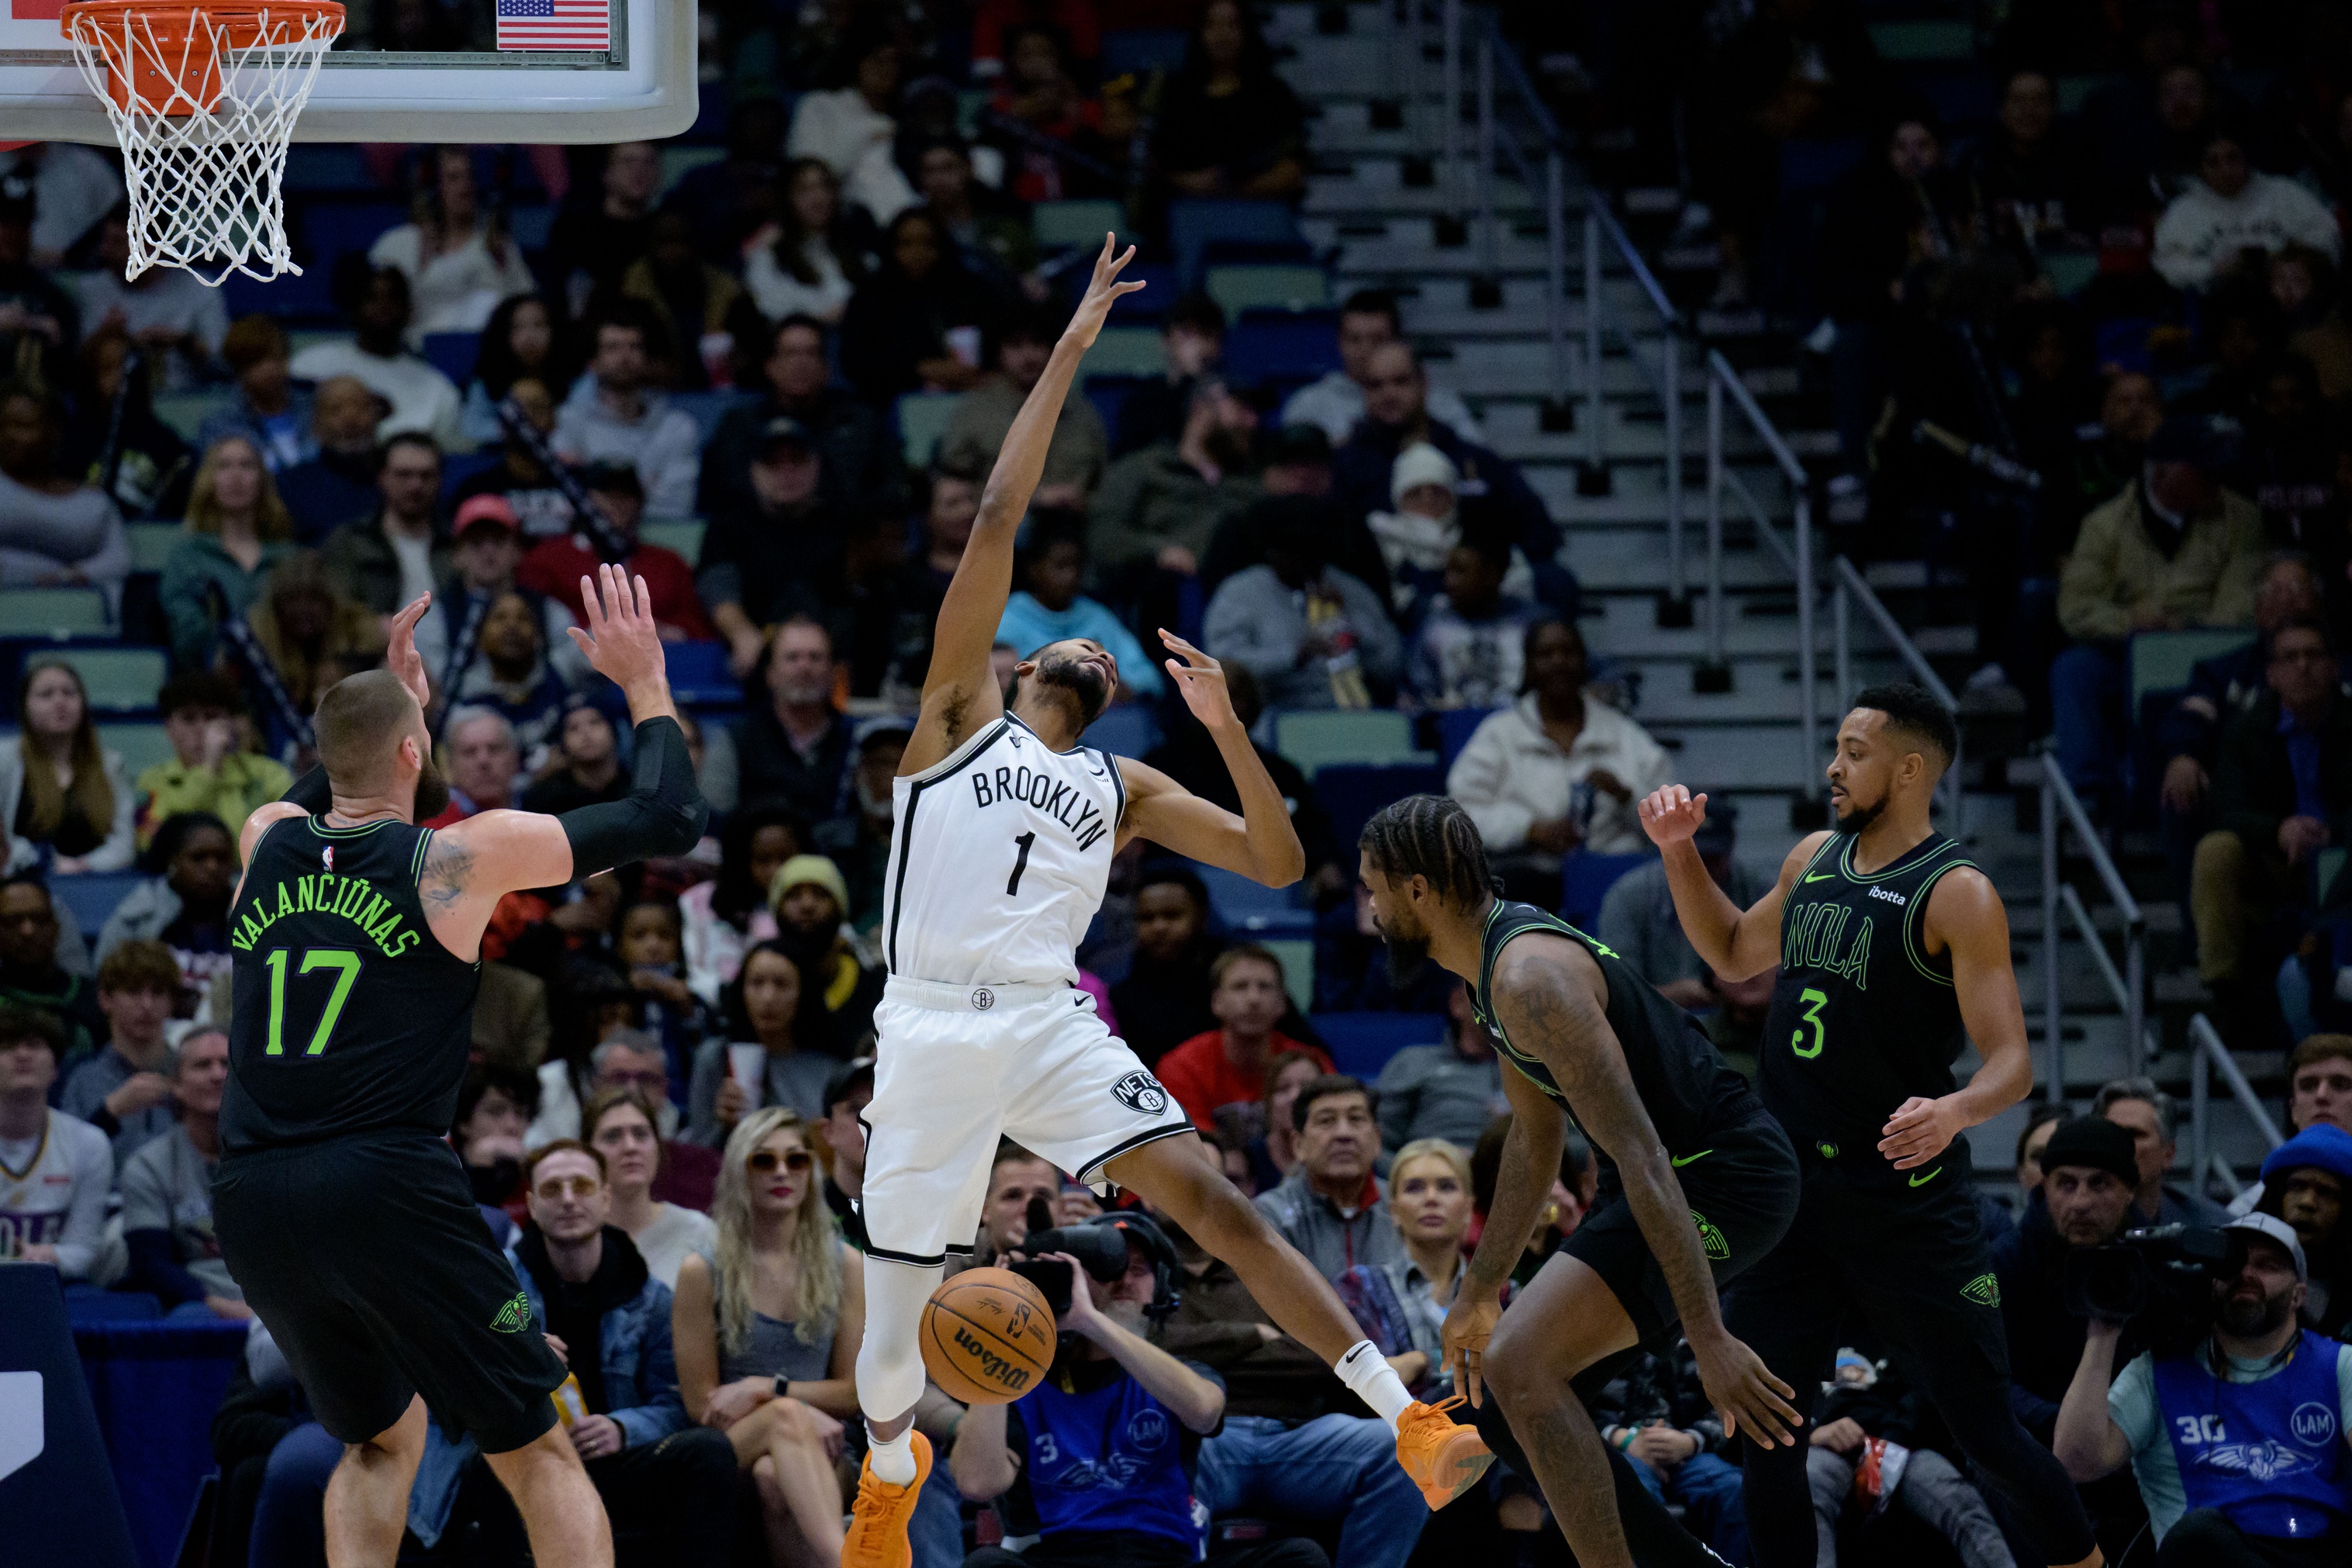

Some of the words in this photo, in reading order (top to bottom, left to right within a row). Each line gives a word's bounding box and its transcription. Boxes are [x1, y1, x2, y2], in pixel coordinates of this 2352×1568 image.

[972, 766, 1107, 851] BROOKLYN
[1007, 831, 1035, 896] 1
[1869, 886, 1906, 906] ibotta
[1784, 903, 1874, 990] NOLA
[264, 948, 364, 1056] 17
[1791, 987, 1828, 1059] 3
[1116, 1072, 1160, 1103] NETS
[1144, 1092, 1159, 1108] B
[954, 1326, 1031, 1390] Wilson
[2176, 1414, 2226, 1445] 30
[2295, 1414, 2330, 1435] LAM
